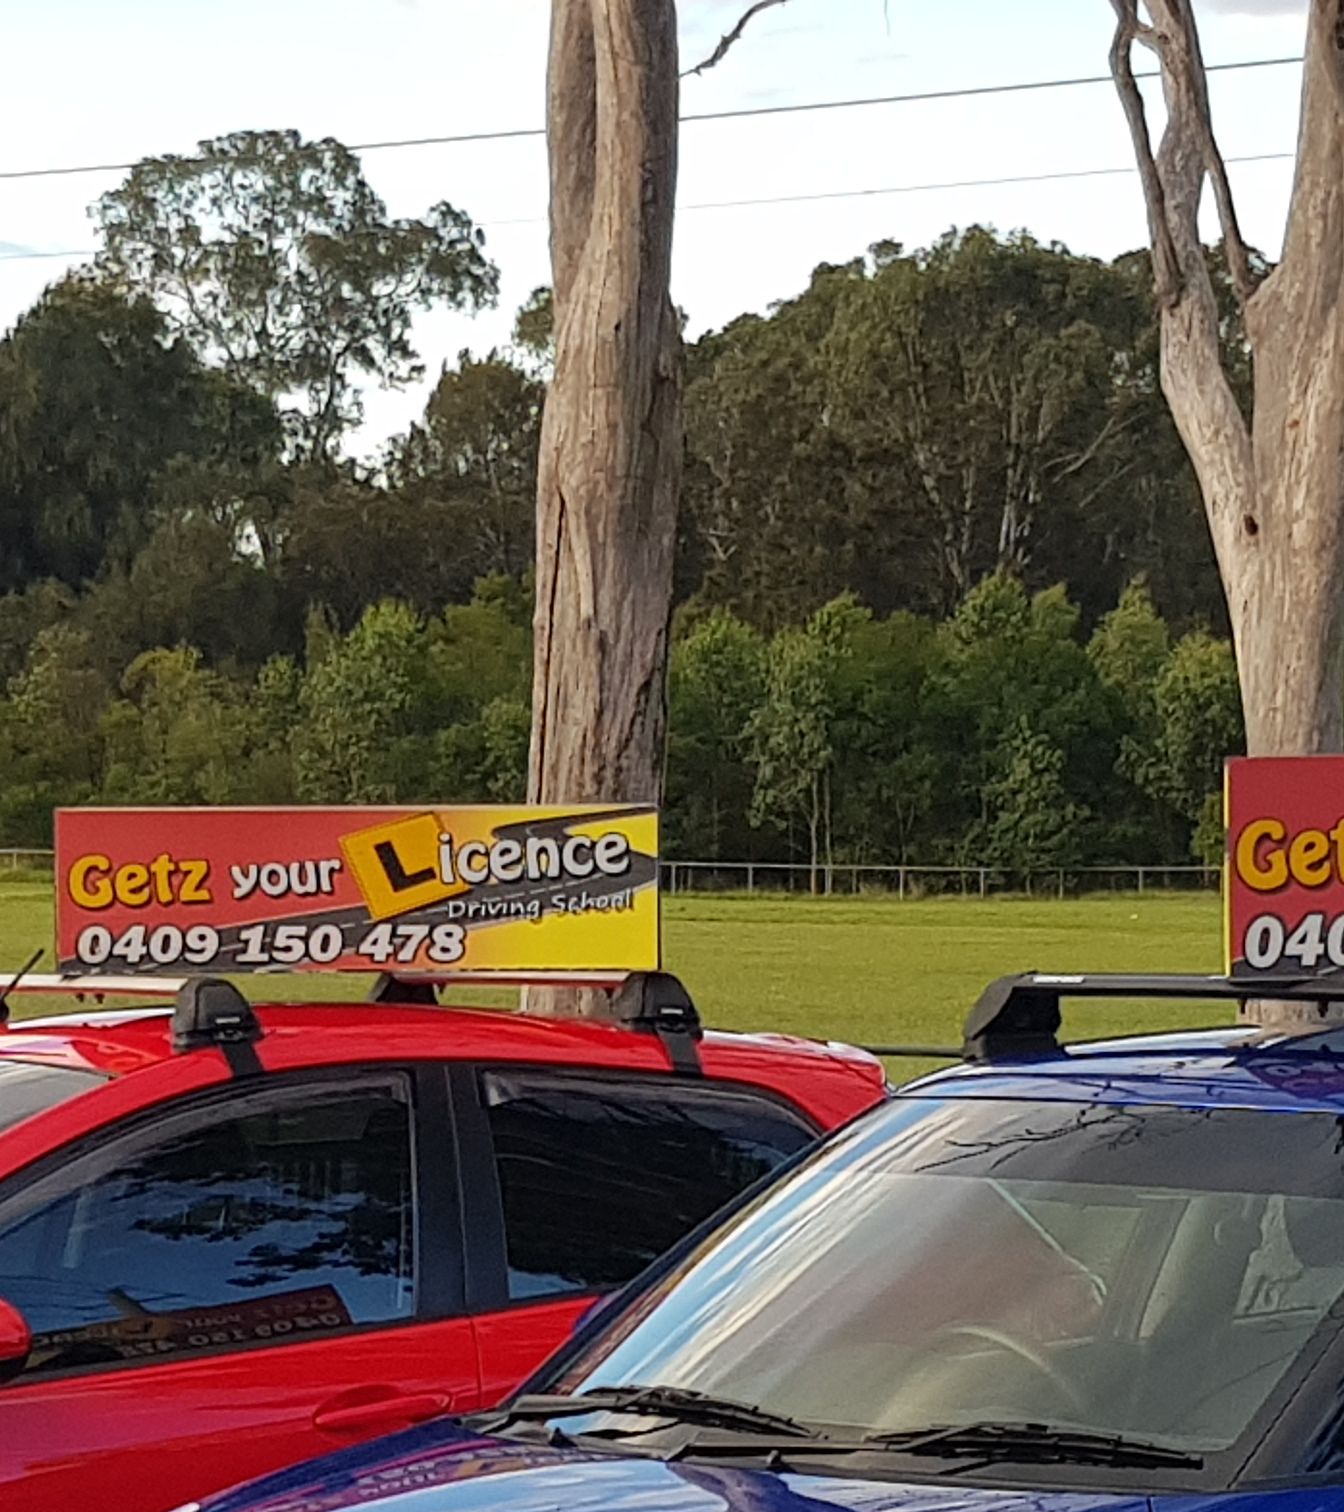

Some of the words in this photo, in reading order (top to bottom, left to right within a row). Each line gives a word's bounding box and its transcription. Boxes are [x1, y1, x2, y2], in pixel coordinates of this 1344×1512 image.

[68, 854, 213, 909] Getz
[230, 858, 342, 900] your
[373, 831, 631, 893] Licence
[447, 898, 542, 921] Driving
[551, 889, 634, 914] School
[76, 924, 220, 965] 0409
[234, 923, 344, 964] 150
[358, 923, 467, 963] 478
